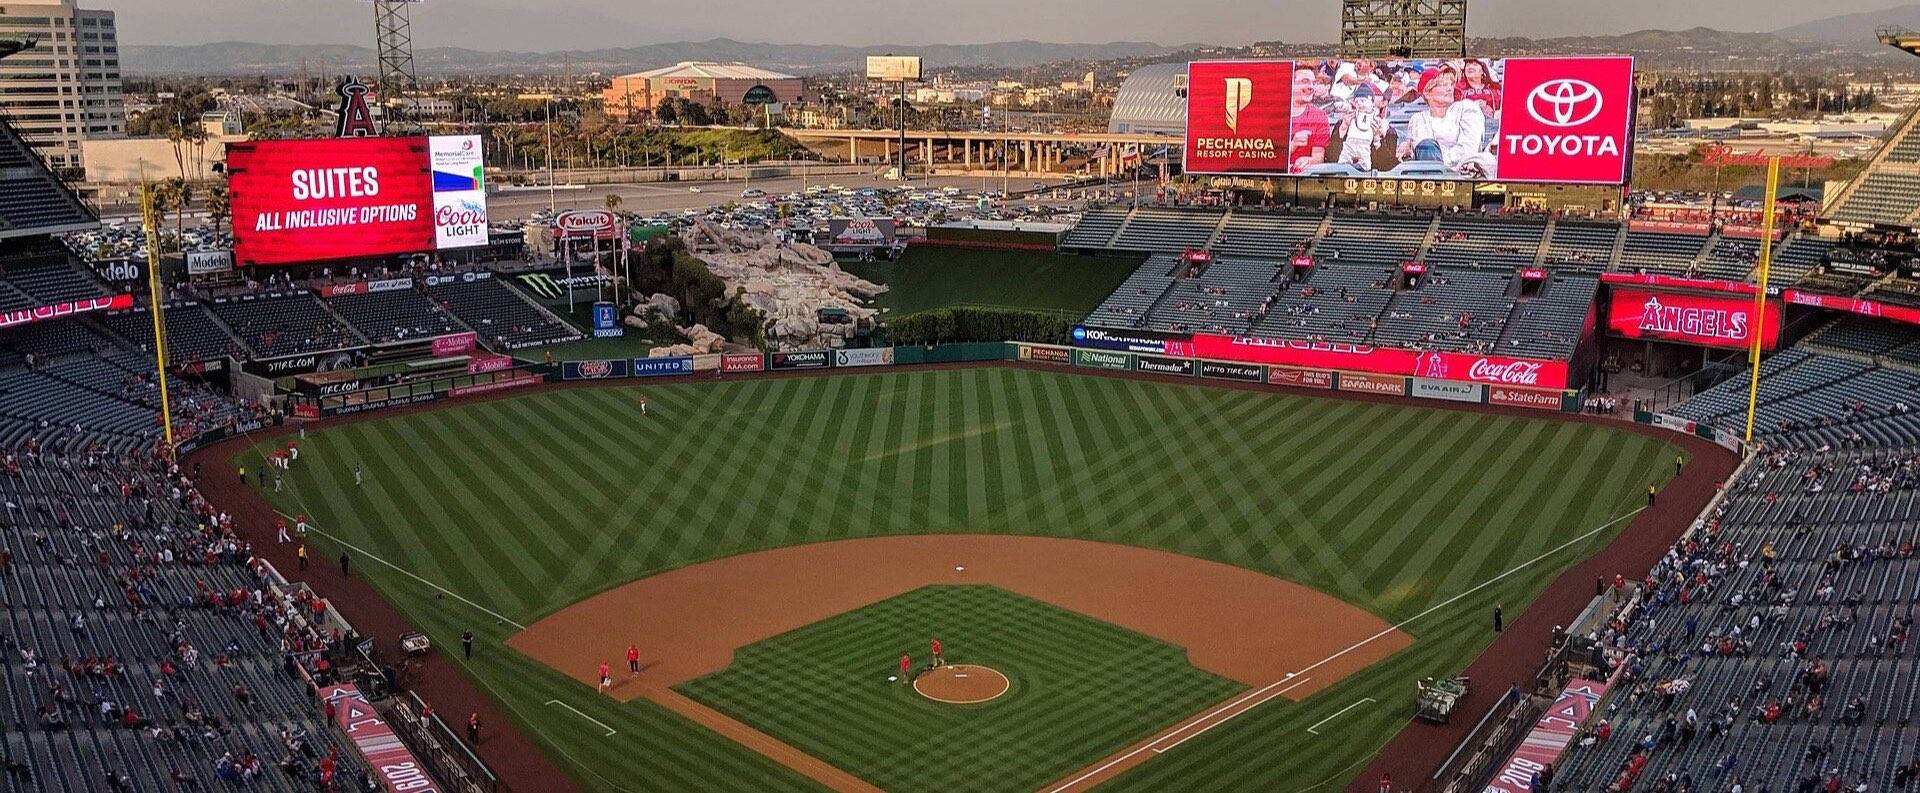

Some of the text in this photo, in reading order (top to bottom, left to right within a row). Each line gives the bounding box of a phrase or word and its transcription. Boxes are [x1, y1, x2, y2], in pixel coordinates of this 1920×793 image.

[1197, 138, 1274, 151] PECHANGA
[1505, 134, 1619, 156] TOYOTA
[1197, 150, 1233, 158] RESORT
[291, 167, 379, 200] SUITES
[1365, 180, 1375, 188] 26
[1404, 182, 1414, 190] 30
[1423, 182, 1433, 190] 42
[256, 204, 417, 231] ALL INCLUSIVE OPTIONS
[436, 205, 486, 226] Coors
[568, 215, 607, 226] Yakult
[849, 219, 876, 229] Coors
[446, 225, 479, 237] LIGHT
[192, 254, 228, 269] Modelo
[1639, 297, 1748, 339] ANGELS
[787, 353, 826, 361] YOKOHAMA
[1033, 347, 1068, 357] PECHANGA
[1091, 352, 1126, 365] National
[636, 362, 680, 371] UNITED
[1139, 360, 1183, 372] Thermador
[1203, 365, 1225, 373] NITTO
[1469, 358, 1544, 385] Coca-Cola
[1342, 380, 1402, 393] SAFARI PARK
[380, 762, 430, 791] 2019
[1500, 757, 1545, 790] 2019
